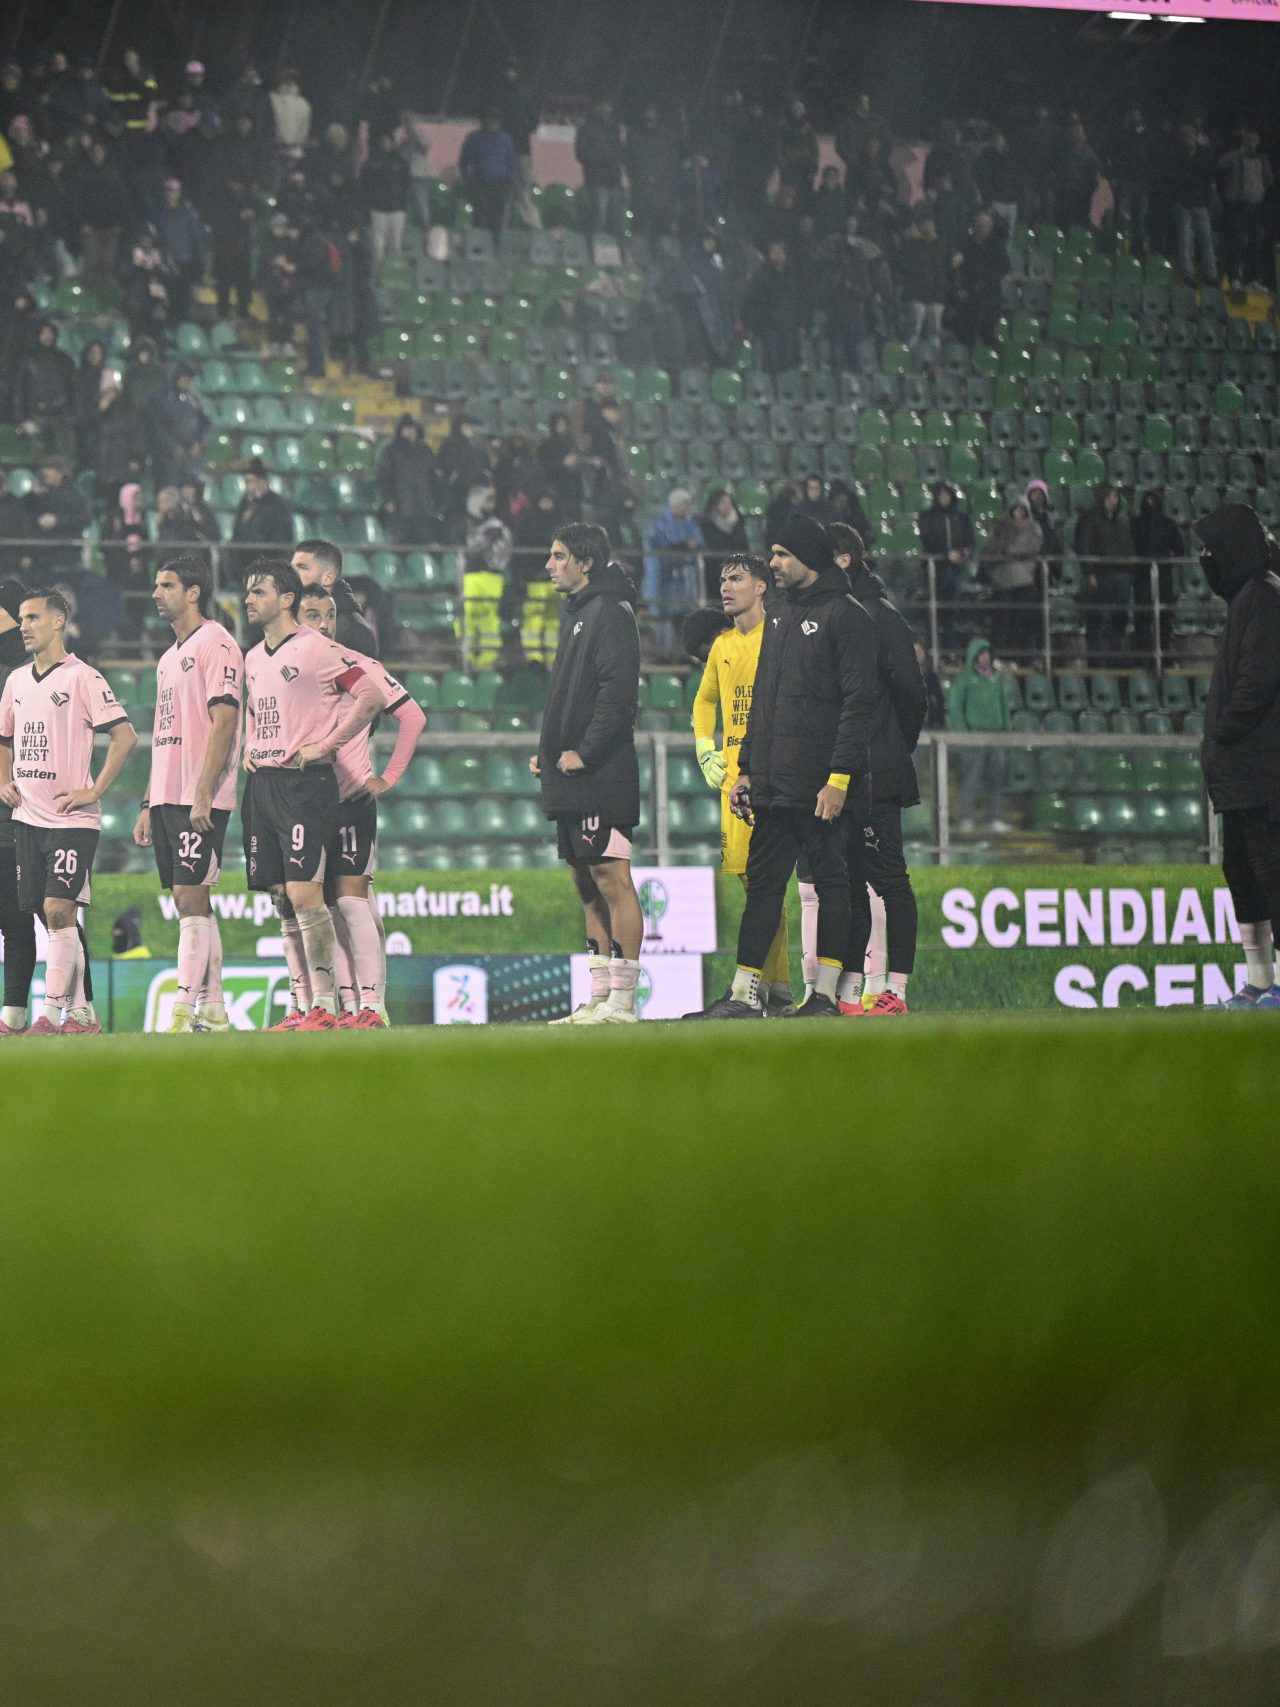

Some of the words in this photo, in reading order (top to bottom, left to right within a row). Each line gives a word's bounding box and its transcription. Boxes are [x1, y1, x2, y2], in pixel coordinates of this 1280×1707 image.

[258, 696, 277, 711] OLD
[733, 699, 752, 712] WIL
[24, 721, 45, 734] OLD
[257, 711, 280, 726] WILD
[21, 735, 48, 748] WILD
[19, 748, 49, 762] WEST
[178, 832, 202, 858] 32
[291, 823, 305, 851] 9
[339, 825, 357, 852] 11
[54, 849, 78, 874] 26
[941, 887, 1274, 948] SCENDIAM
[1054, 963, 1280, 1008] SCEN
